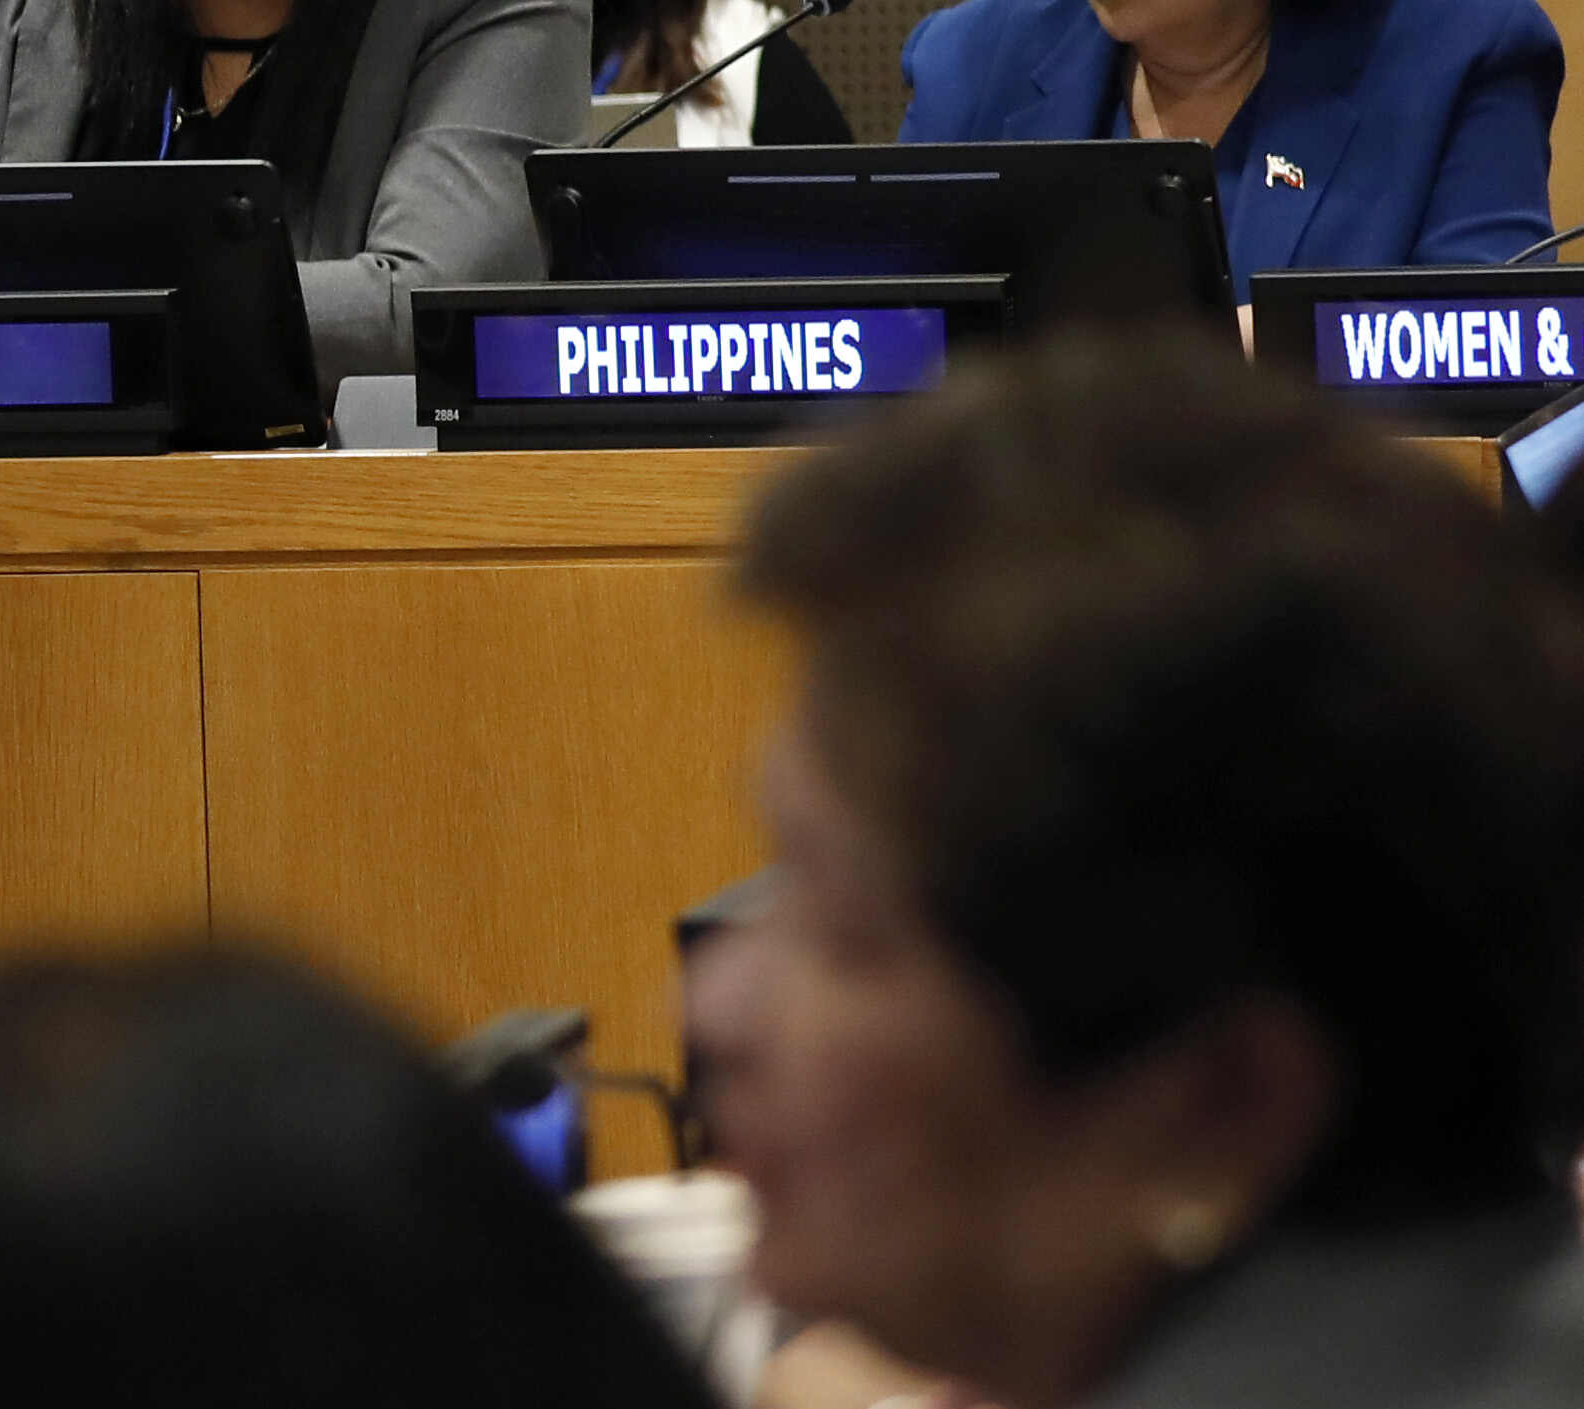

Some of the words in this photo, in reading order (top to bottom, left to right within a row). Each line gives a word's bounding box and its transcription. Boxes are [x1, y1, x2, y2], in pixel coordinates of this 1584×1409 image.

[557, 319, 863, 394] PHILIPPINES
[1341, 309, 1522, 380] WOMEN
[1536, 306, 1575, 377] &
